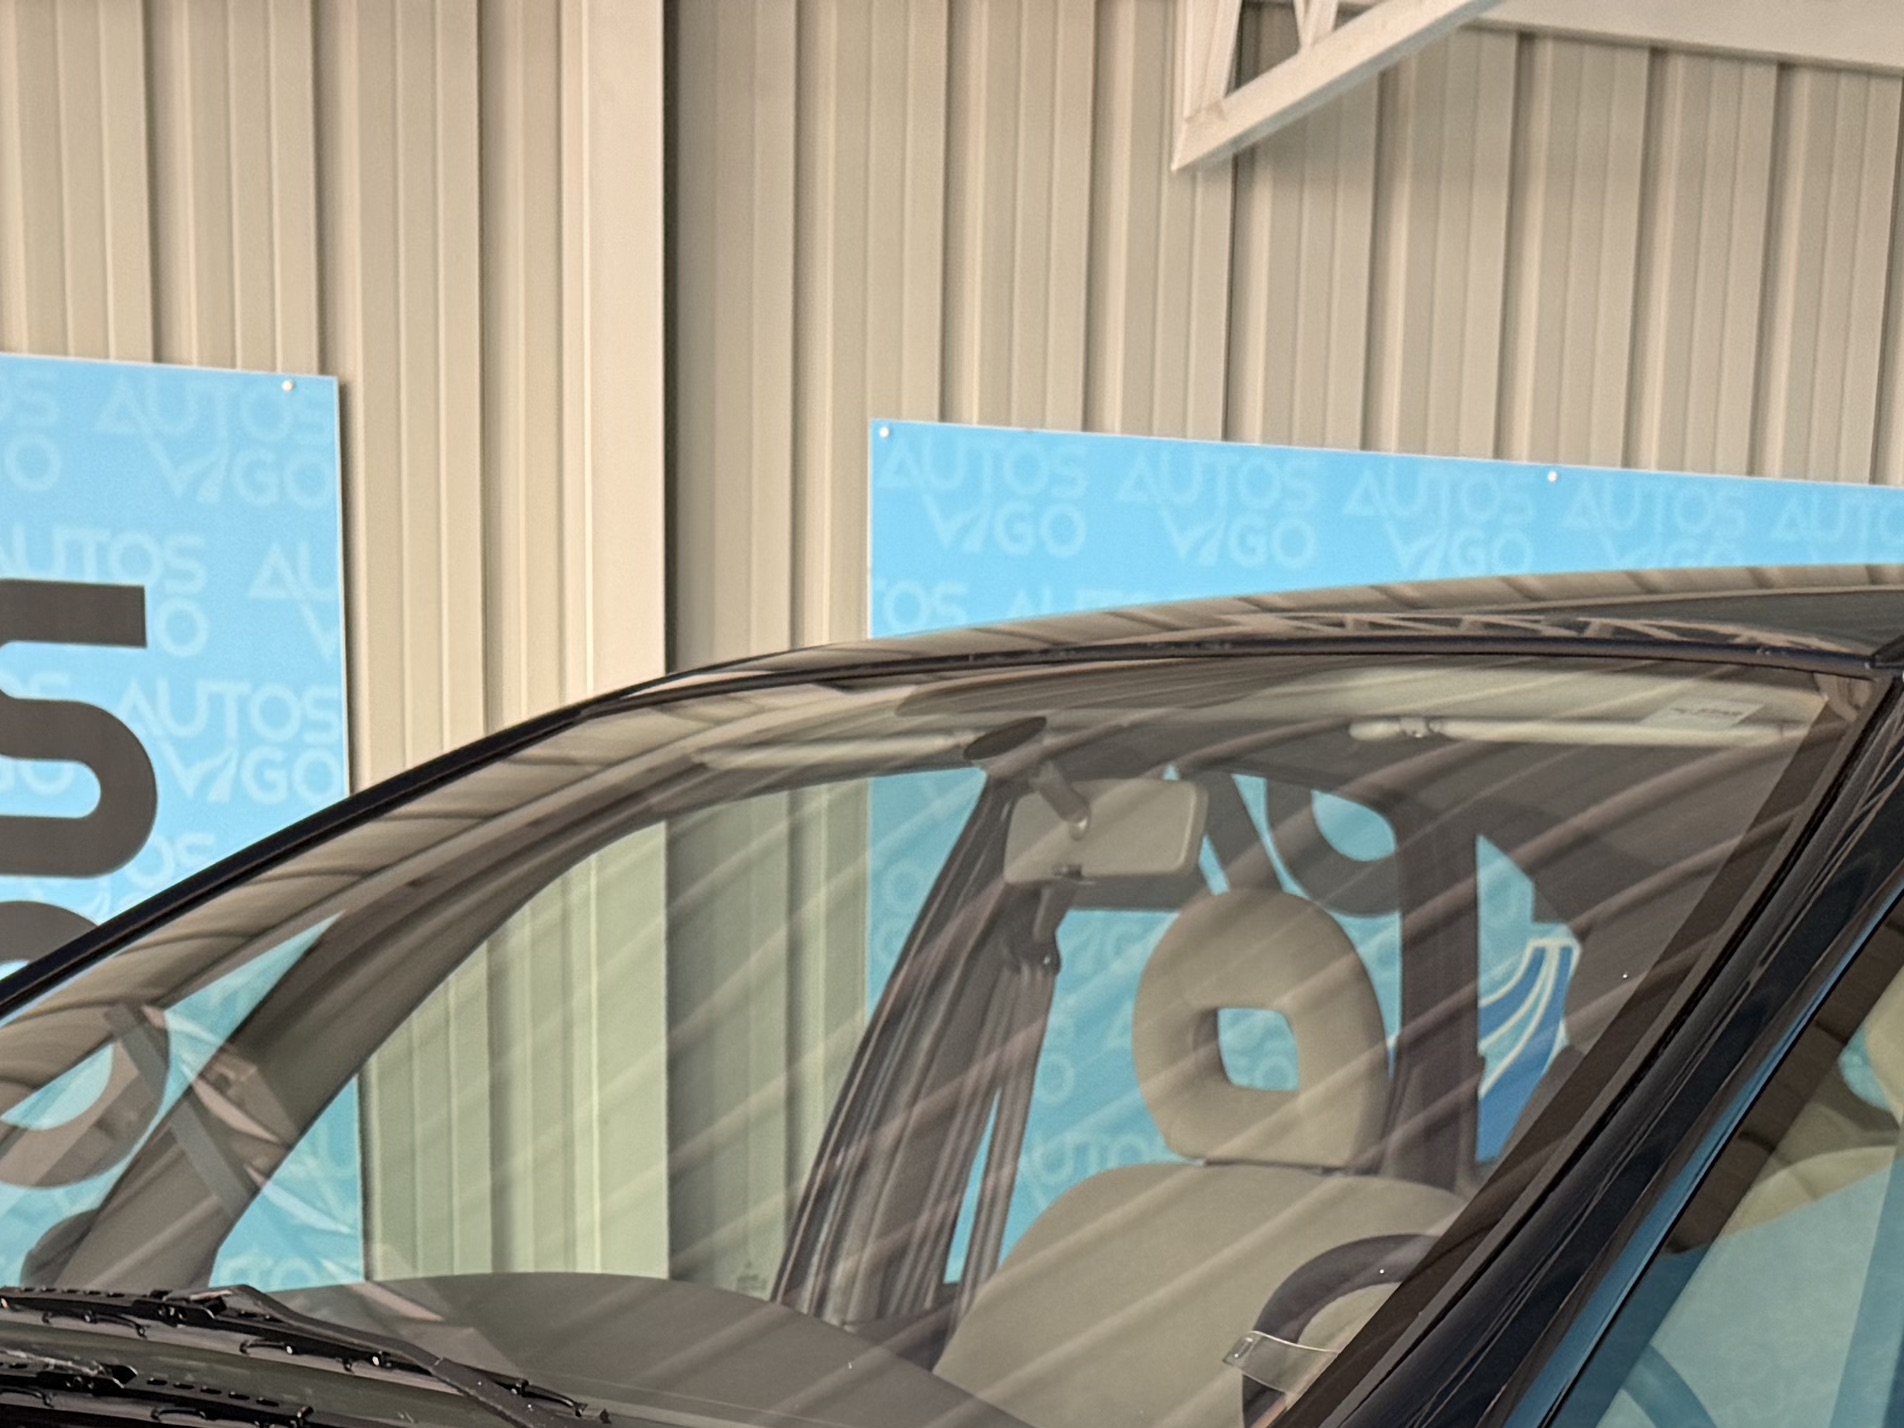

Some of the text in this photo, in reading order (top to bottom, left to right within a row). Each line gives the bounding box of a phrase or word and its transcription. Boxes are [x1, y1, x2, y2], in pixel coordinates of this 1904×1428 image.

[94, 375, 337, 448] AUTOS
[878, 437, 1088, 499] AUTOS
[1115, 450, 1319, 511] AUTOS
[1342, 462, 1536, 526] AUTOS
